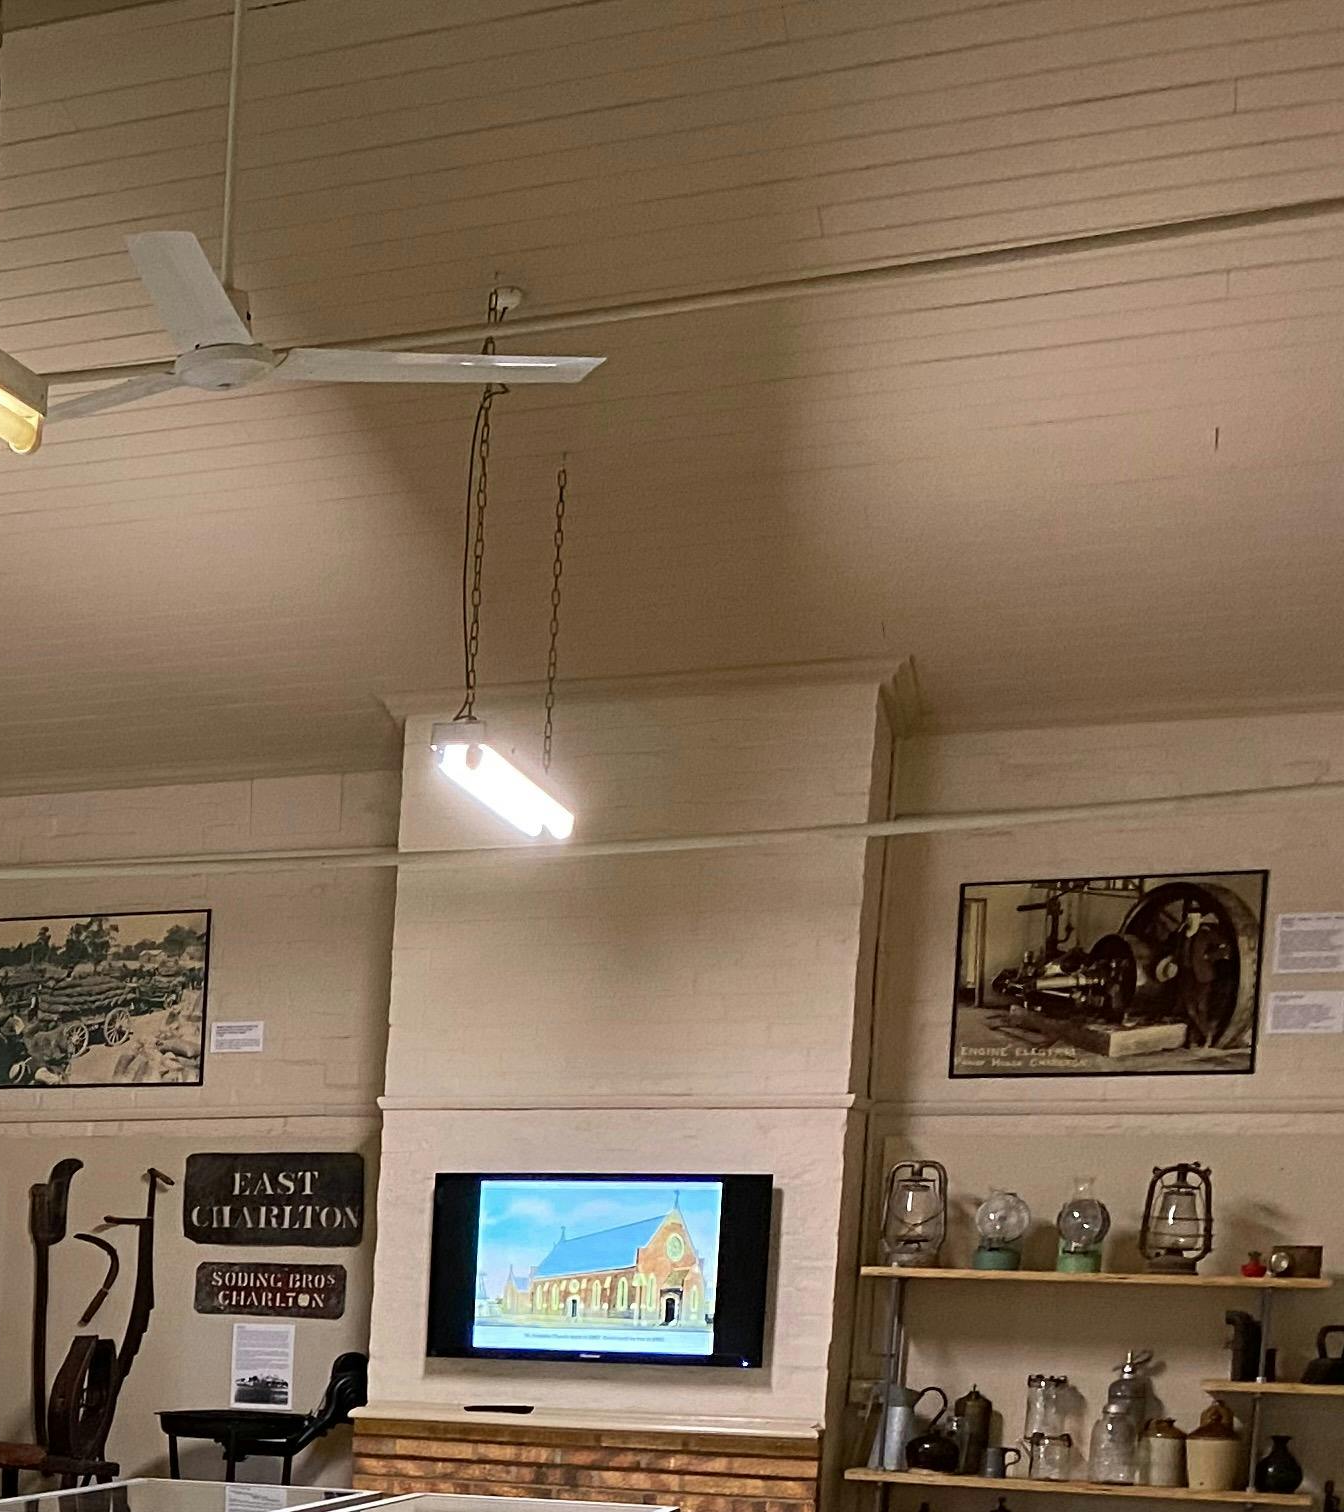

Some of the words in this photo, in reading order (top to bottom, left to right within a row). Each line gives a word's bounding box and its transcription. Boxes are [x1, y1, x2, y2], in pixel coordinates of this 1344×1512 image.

[232, 1171, 318, 1196] EAST
[191, 1205, 360, 1229] CHARLTON
[212, 1271, 282, 1288] SODING
[218, 1290, 325, 1308] CHARLTON
